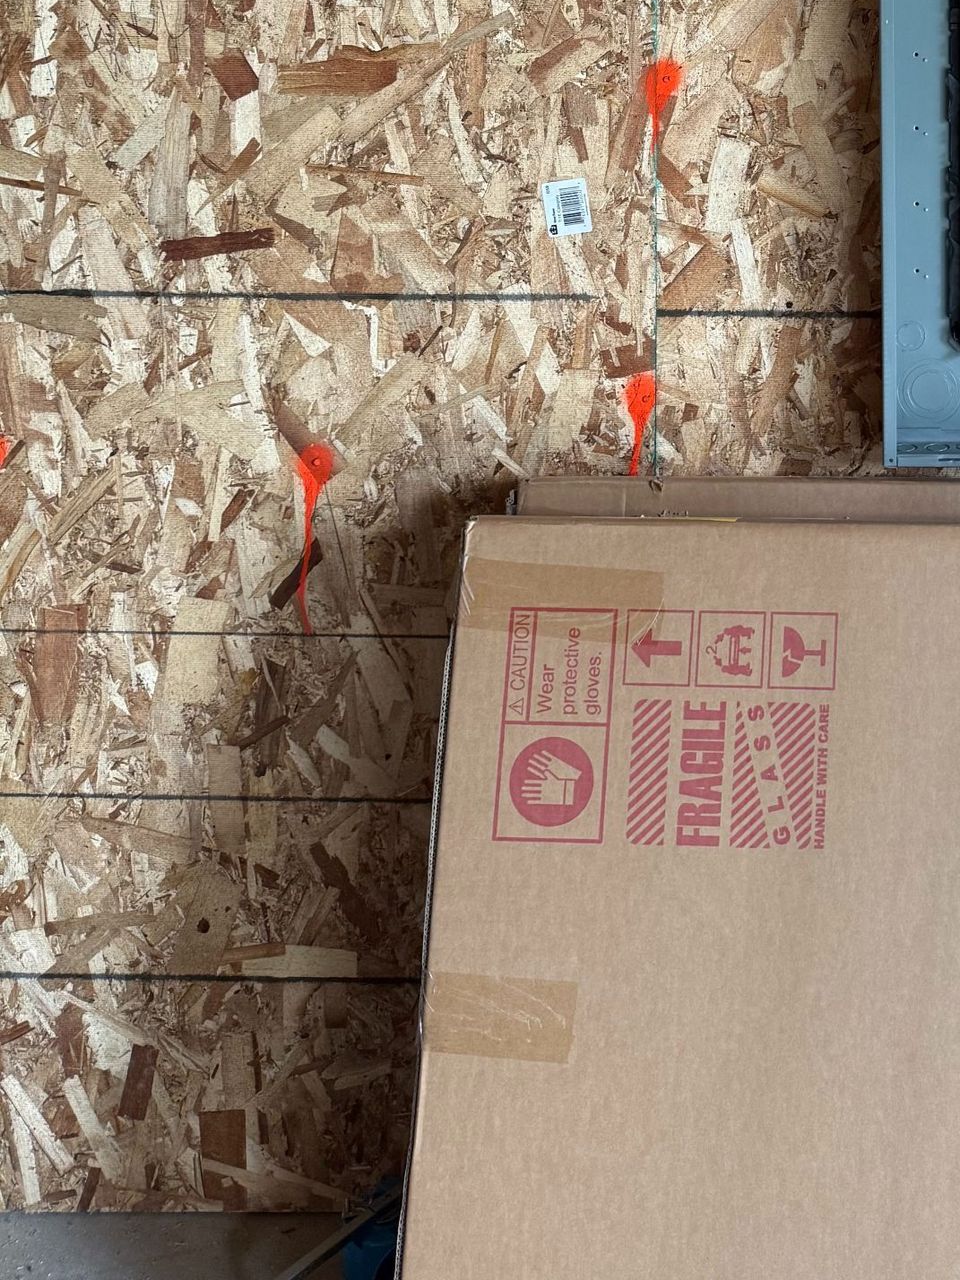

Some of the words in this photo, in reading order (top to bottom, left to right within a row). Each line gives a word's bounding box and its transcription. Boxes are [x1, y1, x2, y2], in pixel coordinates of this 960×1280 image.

[511, 613, 530, 691] CAUTION
[562, 627, 582, 715] protective
[585, 651, 602, 715] gloves.
[536, 663, 554, 714] Wear
[819, 704, 830, 742] CARE
[676, 700, 727, 847] FRAGILE
[747, 704, 791, 845] GLASS
[817, 747, 829, 786] WITH
[814, 789, 828, 850] HANDLE
